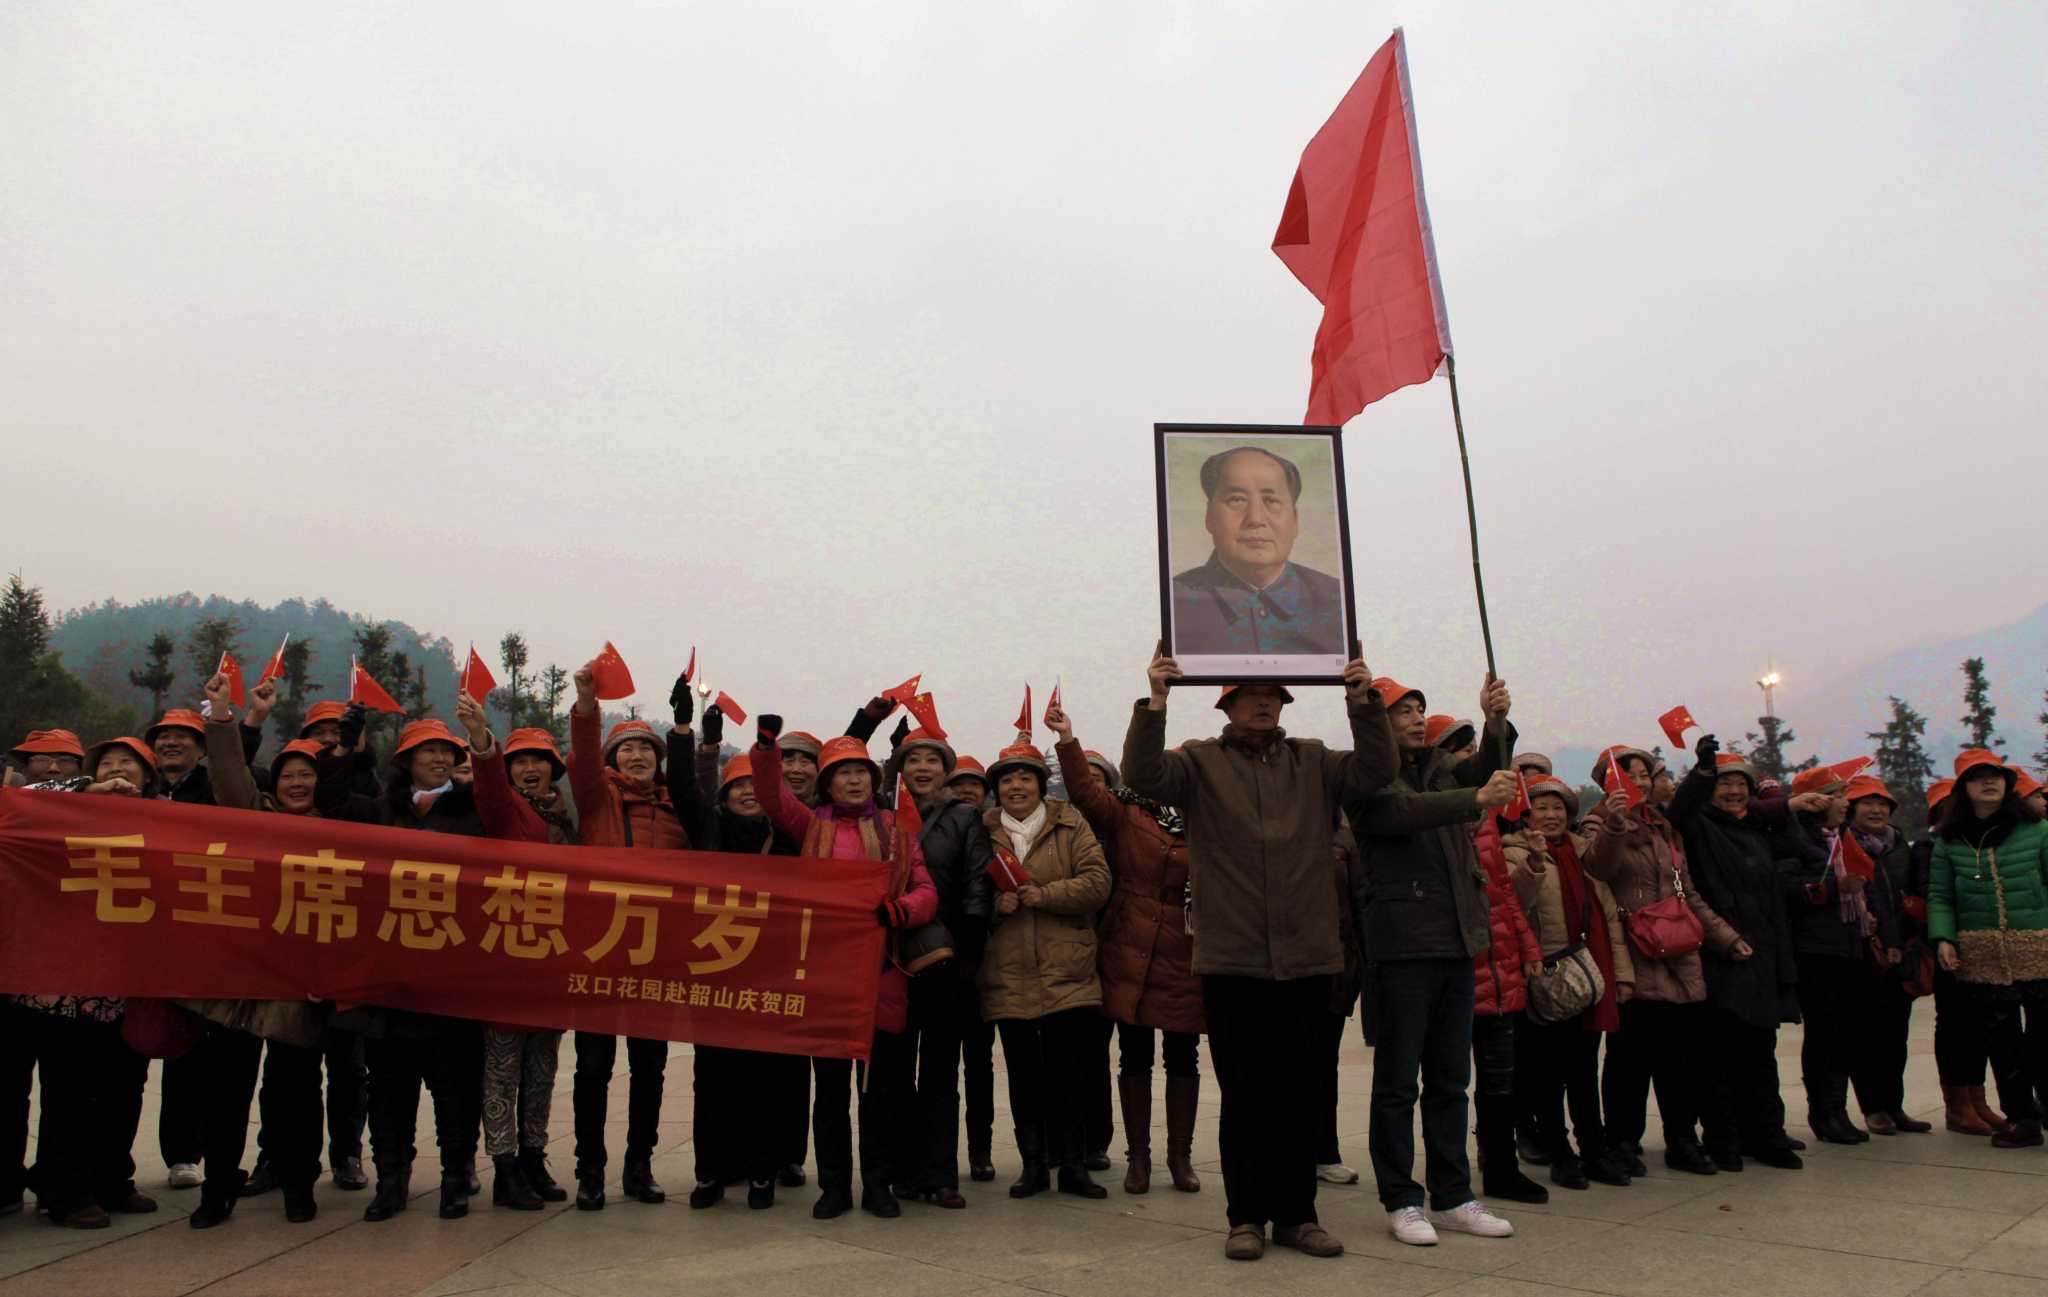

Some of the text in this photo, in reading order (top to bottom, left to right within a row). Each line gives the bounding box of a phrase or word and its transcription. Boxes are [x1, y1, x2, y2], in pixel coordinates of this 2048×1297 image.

[60, 834, 814, 981] 毛主席思想万岁!
[567, 973, 807, 1017] 汉口花园赴韶山庆贺团
